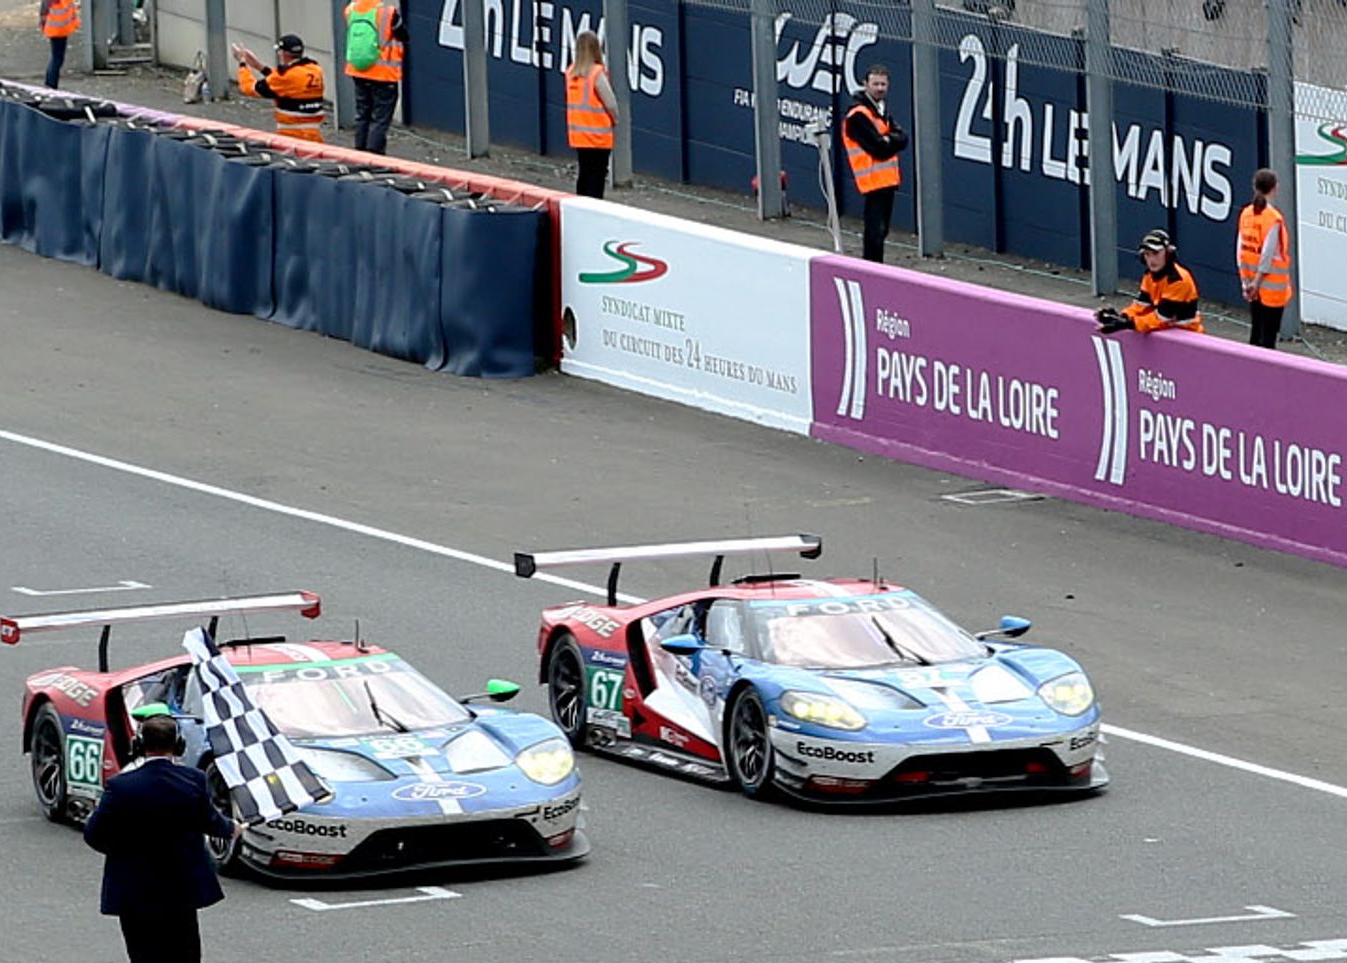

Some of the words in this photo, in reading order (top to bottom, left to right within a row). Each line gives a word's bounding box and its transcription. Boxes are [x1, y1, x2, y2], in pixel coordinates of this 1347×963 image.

[775, 12, 878, 95] WEC
[1042, 103, 1091, 185] LE
[1112, 120, 1232, 221] MANS
[602, 295, 650, 323] SYNDICAT
[653, 312, 685, 332] MIXTE
[876, 308, 911, 340] Région
[603, 329, 617, 348] DU
[619, 333, 661, 360] CIRCUIT
[664, 345, 684, 365] DES
[685, 338, 701, 369] 24
[704, 355, 745, 381] HEURES
[748, 366, 763, 384] DU
[766, 371, 797, 394] MANS
[877, 347, 928, 407] PAYS
[933, 360, 961, 415] DE
[966, 368, 993, 423] LA
[998, 376, 1059, 439] LOIRE
[1138, 368, 1176, 401] Région
[1140, 409, 1196, 471] PAYS
[1202, 423, 1233, 480] DE
[1238, 432, 1268, 489] LA
[1274, 440, 1342, 508] LOIRE
[786, 596, 910, 617] FORD
[263, 661, 390, 683] FORD
[591, 671, 623, 709] 67
[941, 713, 997, 727] Ford
[70, 741, 98, 783] 66
[797, 741, 874, 763] EcoBoost
[412, 785, 469, 799] Ford
